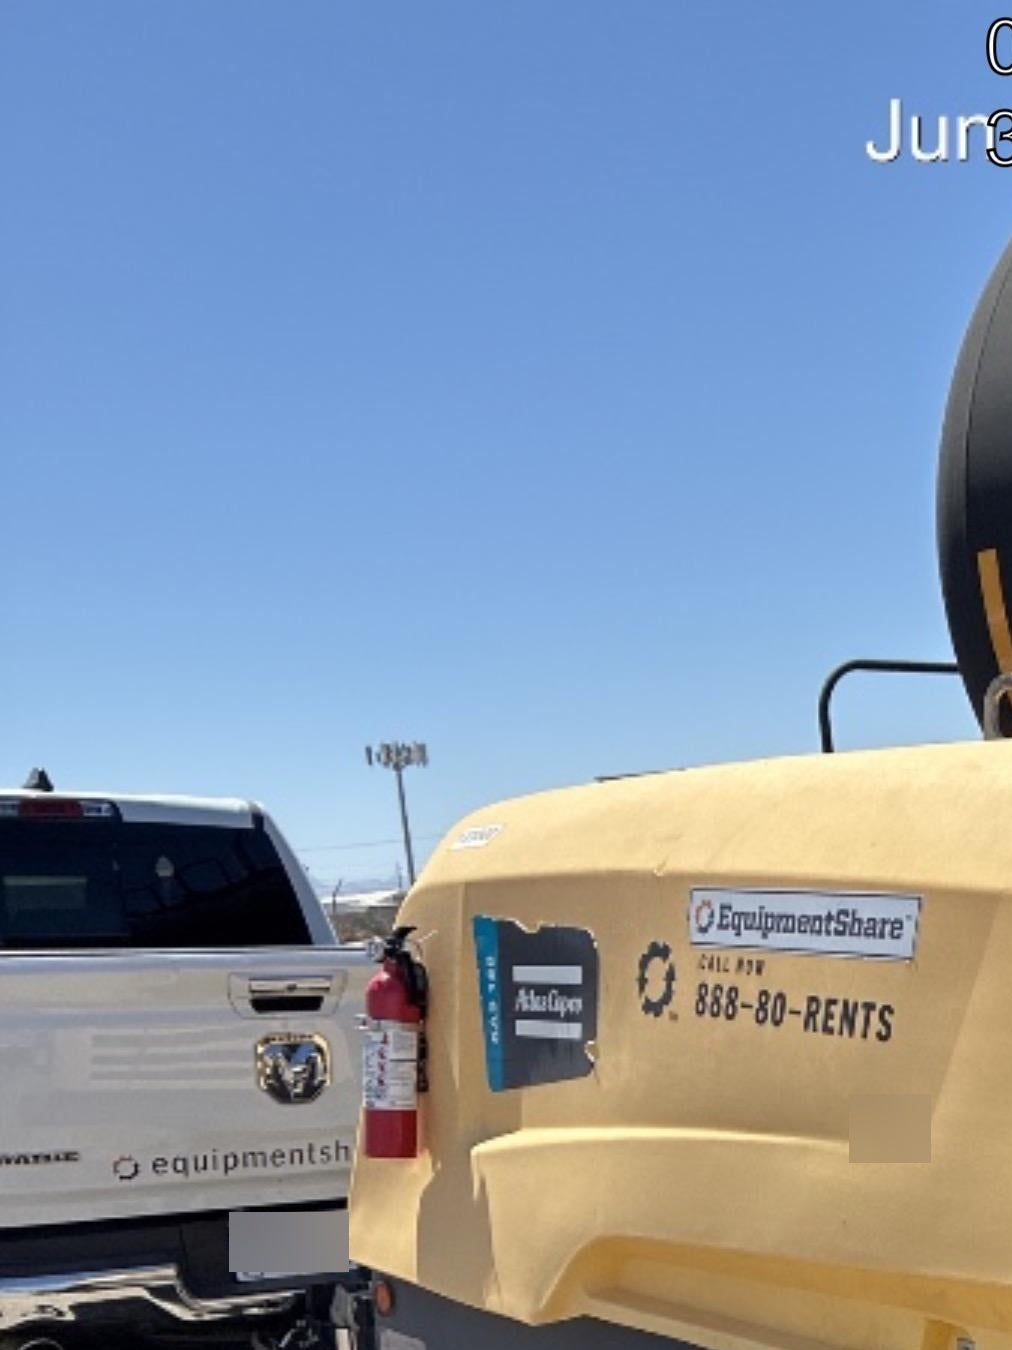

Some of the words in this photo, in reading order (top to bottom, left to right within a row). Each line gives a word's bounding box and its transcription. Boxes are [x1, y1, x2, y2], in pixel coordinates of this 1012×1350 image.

[716, 903, 904, 940] EquipmentShare
[697, 953, 730, 973] CALL
[735, 958, 766, 976] NOW
[695, 981, 895, 1043] 888-80-RENTS
